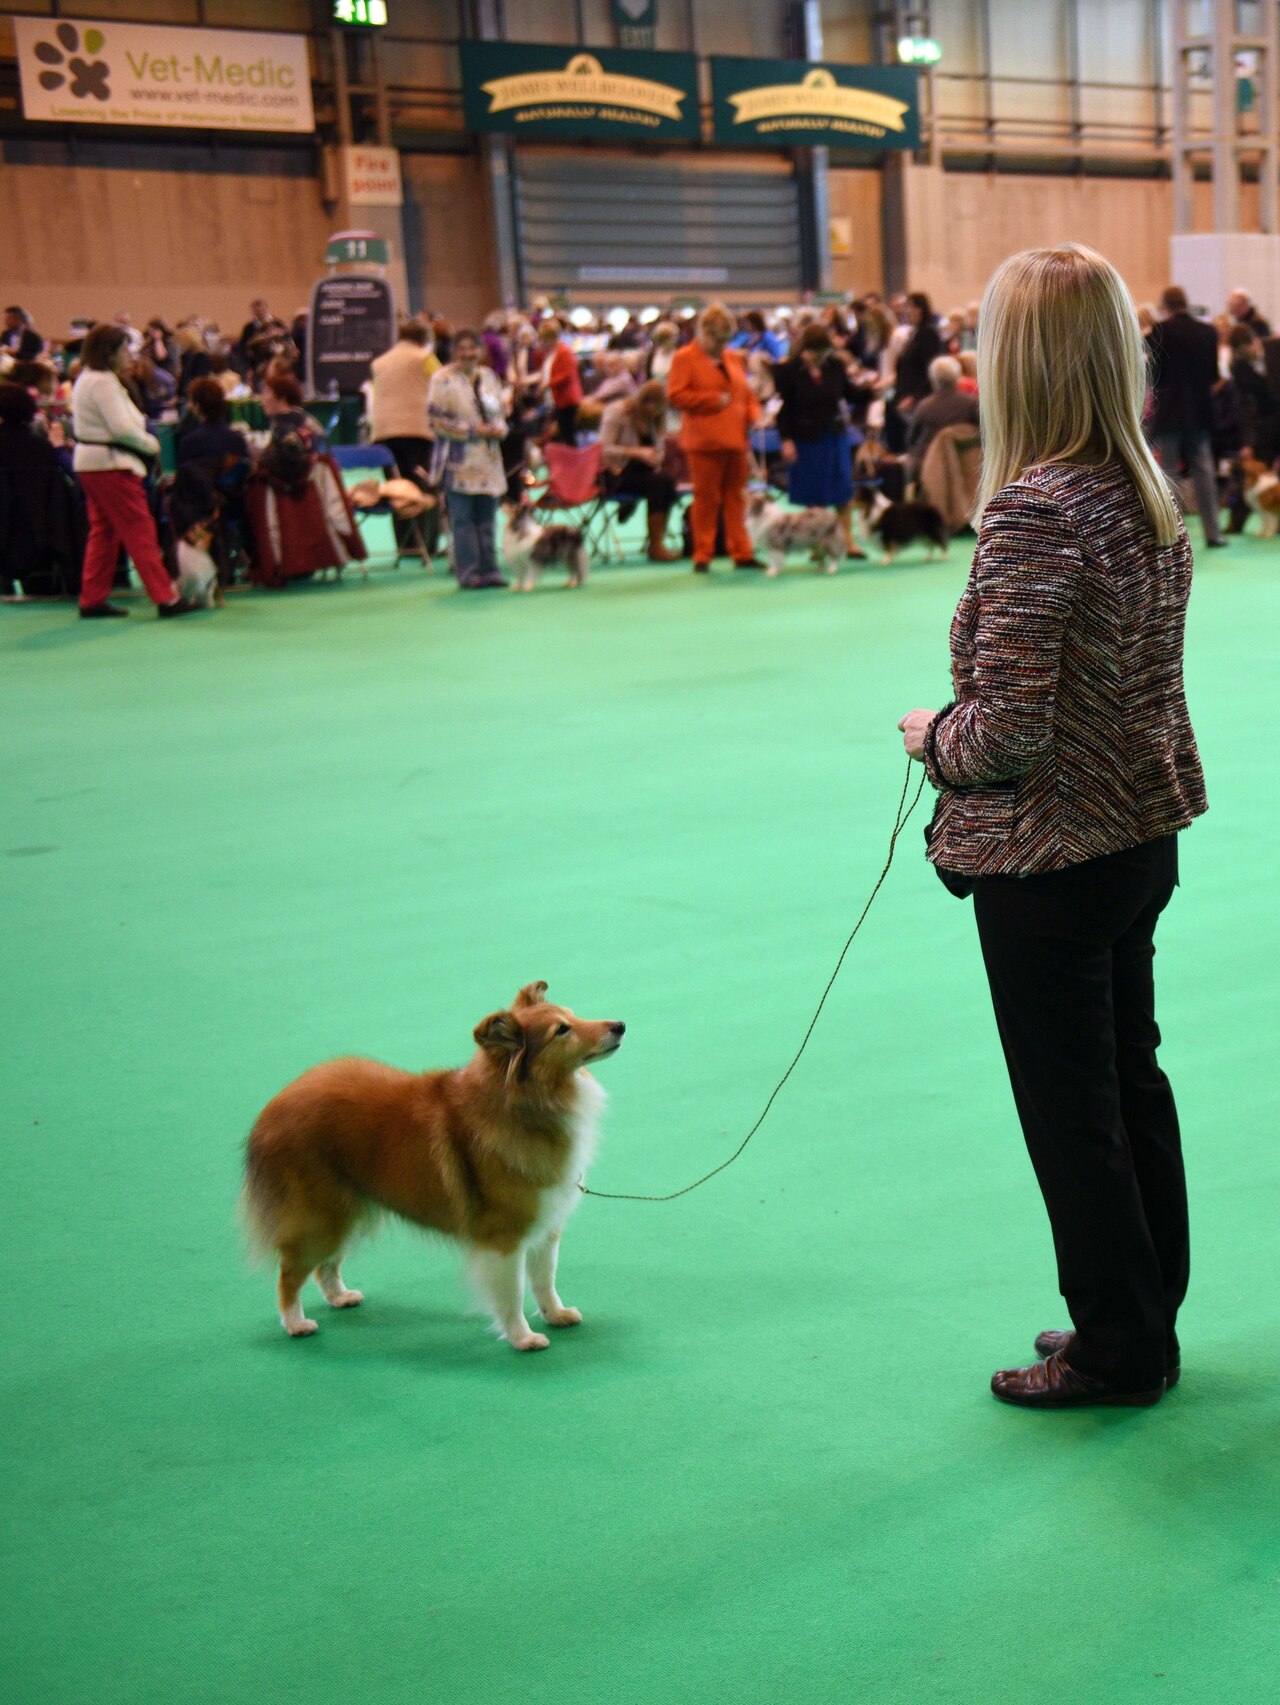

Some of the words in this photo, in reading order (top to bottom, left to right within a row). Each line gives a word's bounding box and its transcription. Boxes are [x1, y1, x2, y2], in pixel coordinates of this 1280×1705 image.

[125, 50, 296, 88] Vet-Medic
[129, 87, 299, 108] www.vet-medic.com
[355, 156, 390, 171] Fire
[352, 177, 398, 194] point
[347, 239, 367, 258] 11
